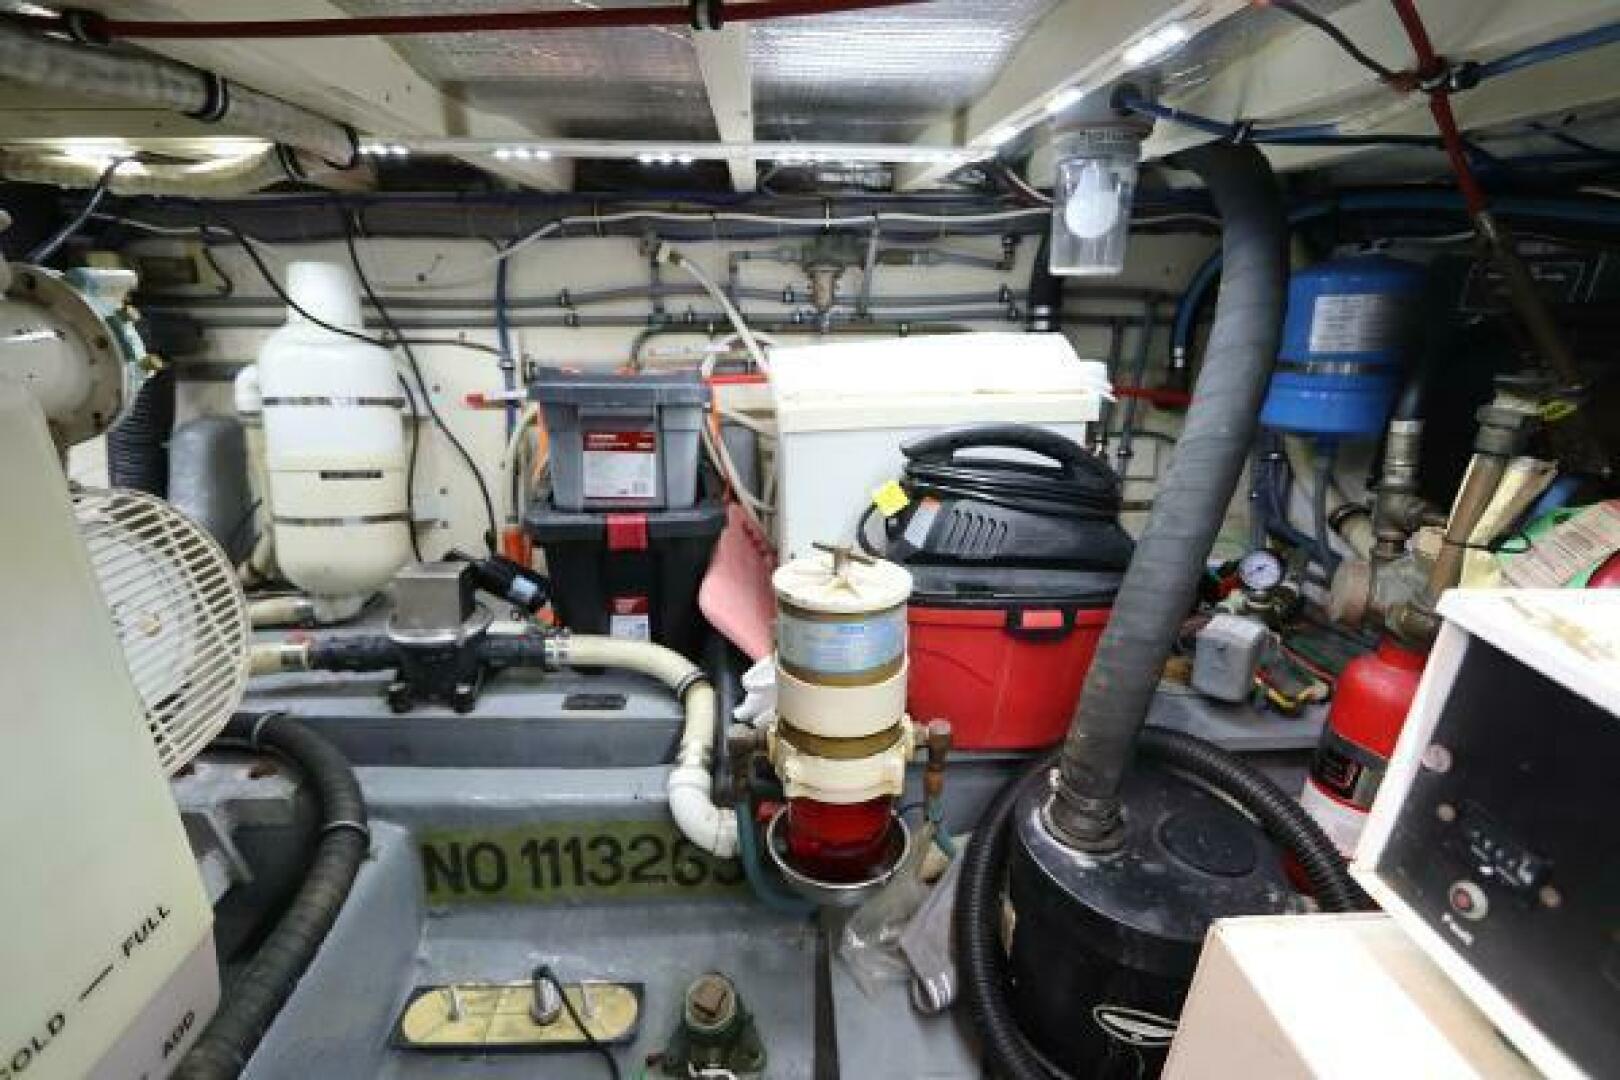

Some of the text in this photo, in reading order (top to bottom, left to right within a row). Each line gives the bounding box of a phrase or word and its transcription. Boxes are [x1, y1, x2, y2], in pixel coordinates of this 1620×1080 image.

[420, 841, 508, 893] NO
[122, 905, 171, 958] FULL
[162, 1010, 195, 1060] ADD
